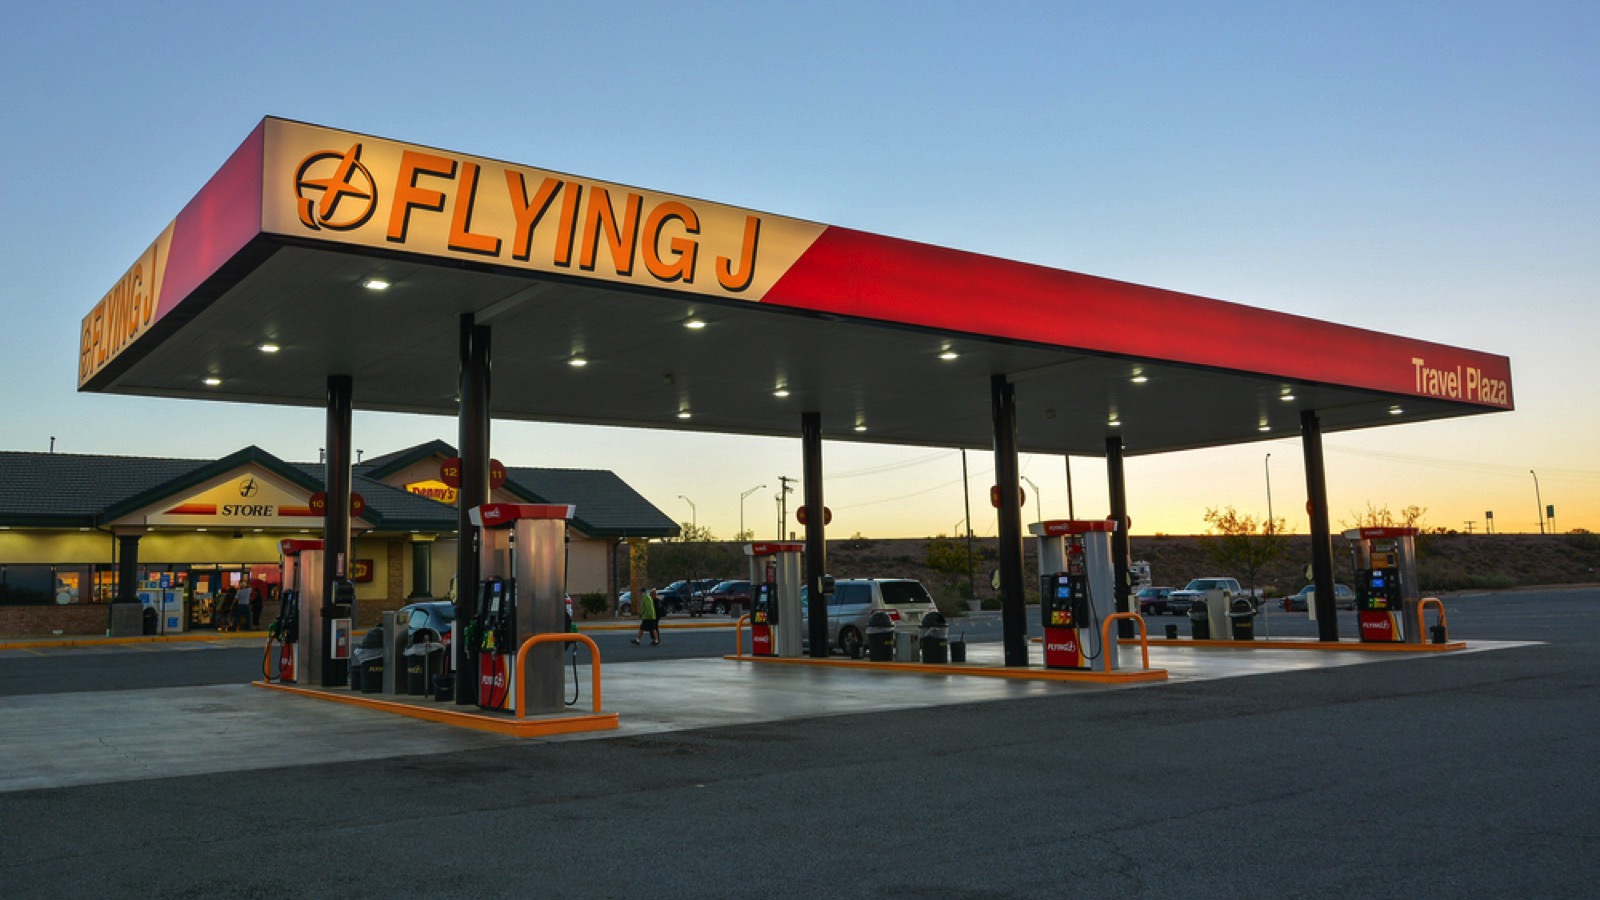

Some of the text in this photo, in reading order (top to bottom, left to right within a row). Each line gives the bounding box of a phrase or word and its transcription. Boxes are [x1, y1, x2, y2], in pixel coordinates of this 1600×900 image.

[386, 149, 761, 292] FLYING J
[90, 244, 158, 376] FLYING J
[1411, 357, 1508, 405] Travel Plaza
[442, 467, 458, 477] 12
[491, 469, 502, 479] 11
[412, 486, 454, 500] Denny's
[222, 504, 275, 517] STORE
[312, 501, 324, 509] 10
